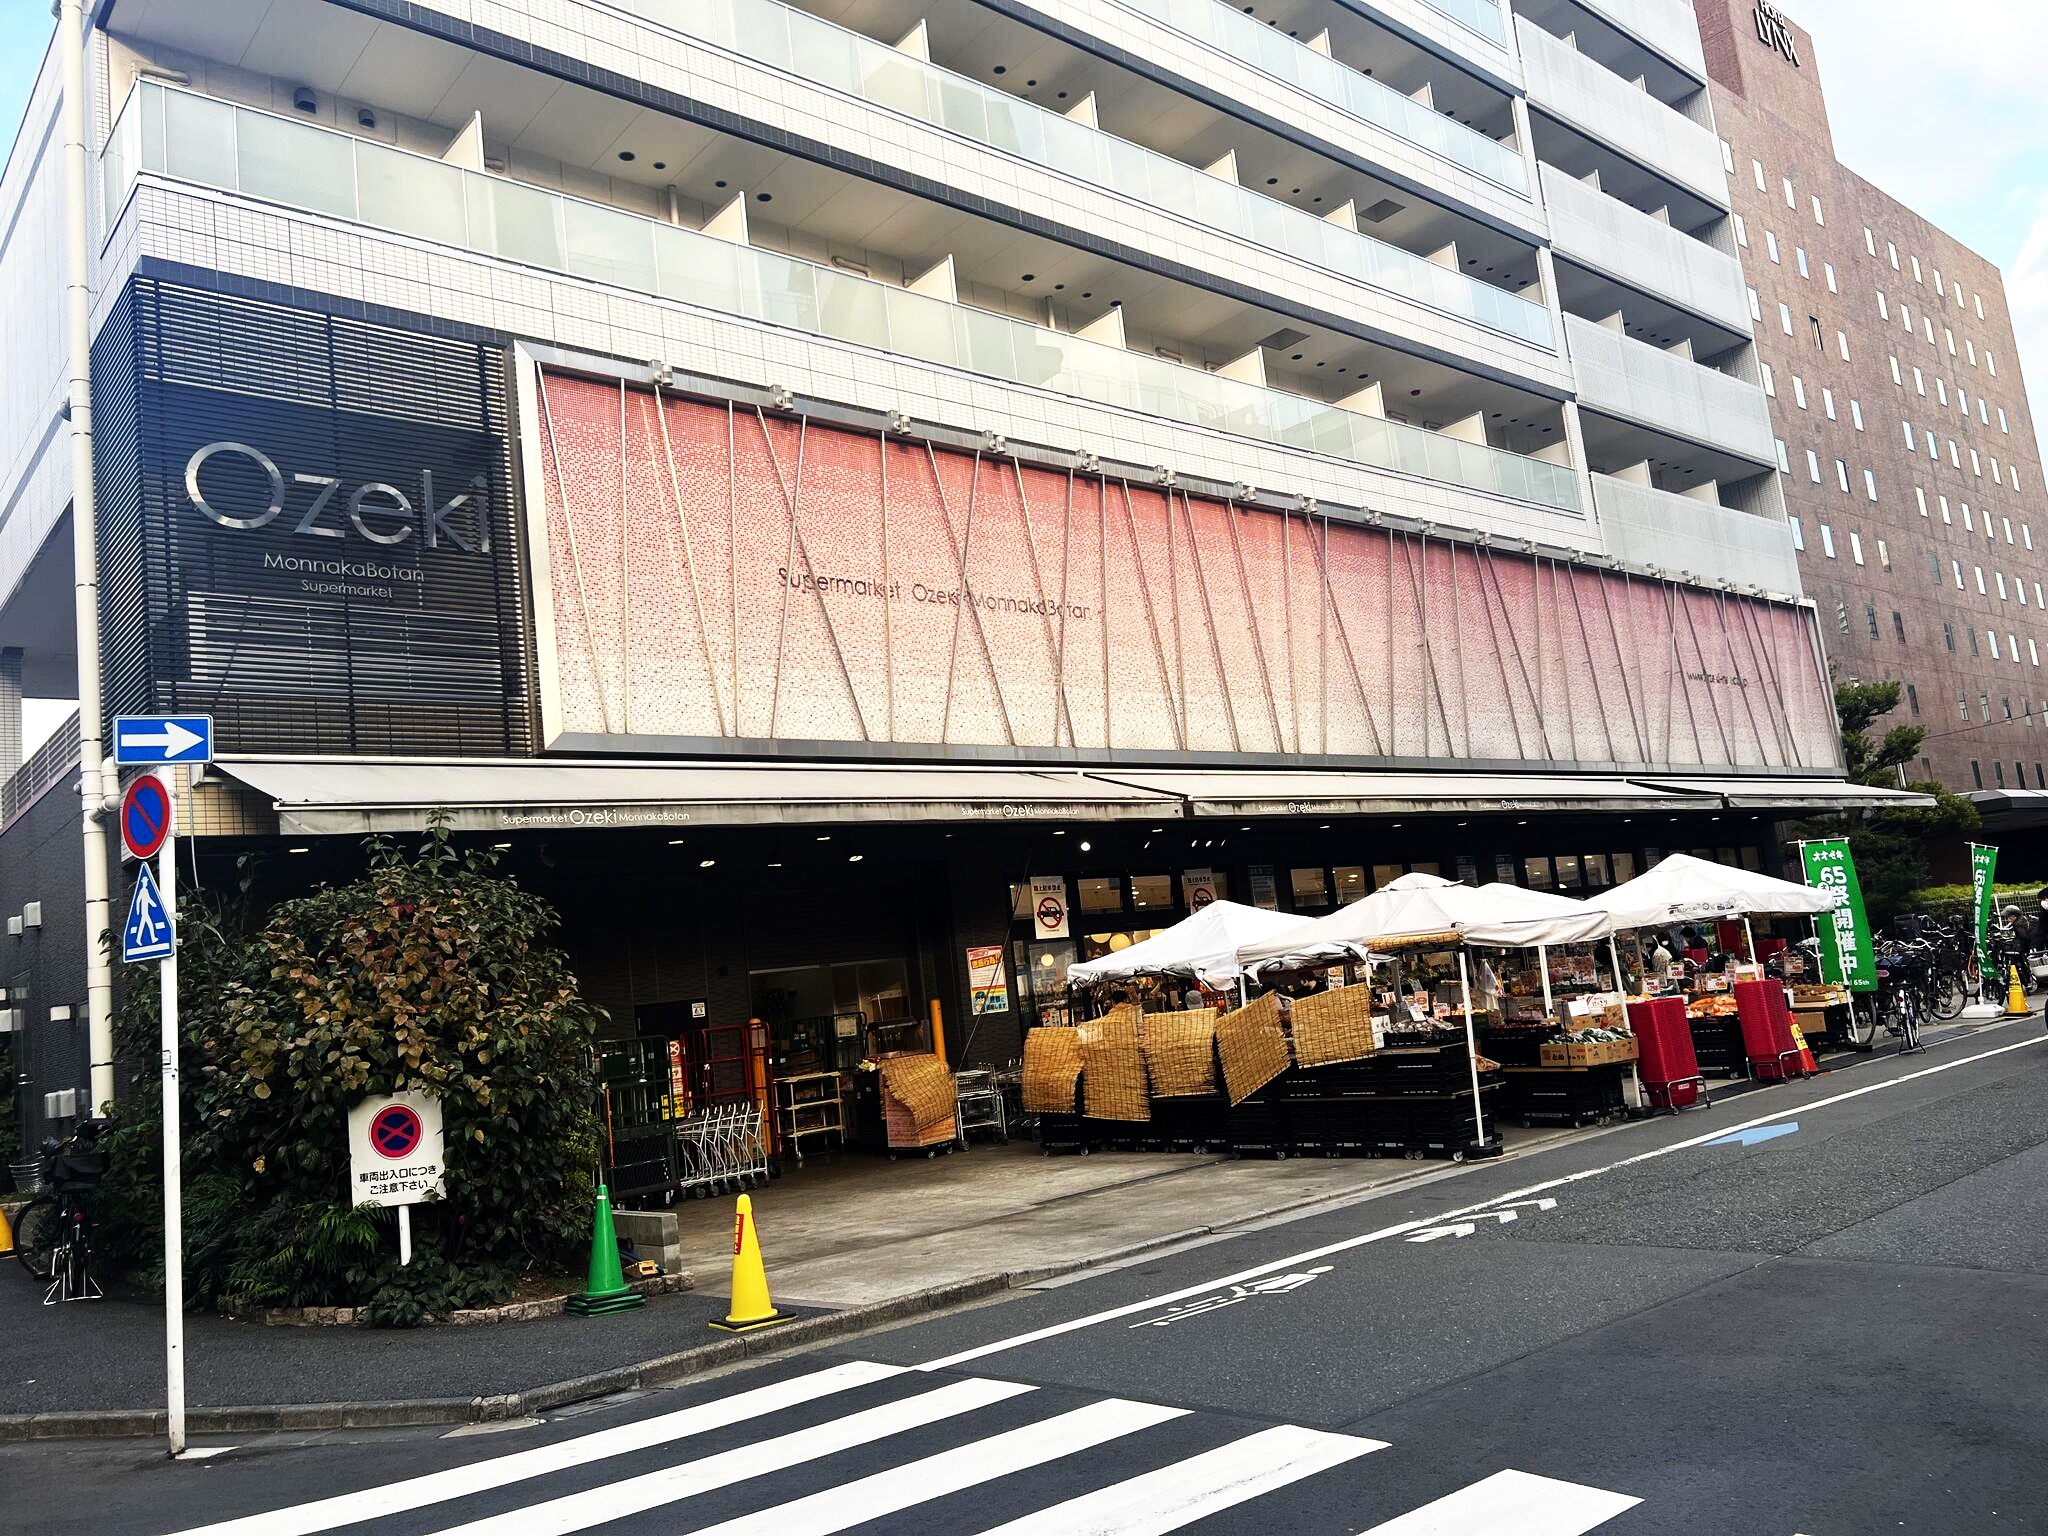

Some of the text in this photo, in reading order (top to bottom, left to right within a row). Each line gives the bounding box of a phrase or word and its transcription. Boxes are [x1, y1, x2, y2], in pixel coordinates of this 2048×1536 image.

[184, 441, 491, 553] Ozeki
[263, 552, 425, 583] MonnakaBotan
[301, 579, 393, 599] Supermarket
[777, 566, 901, 599] Supermarket
[502, 808, 690, 825] Supermarket Ozeki MonnakaBotan
[1002, 804, 1034, 817] Ozeki
[1288, 802, 1312, 813] Ozeki
[1820, 865, 1848, 885] 65
[359, 1165, 437, 1183] 車両出入口につき
